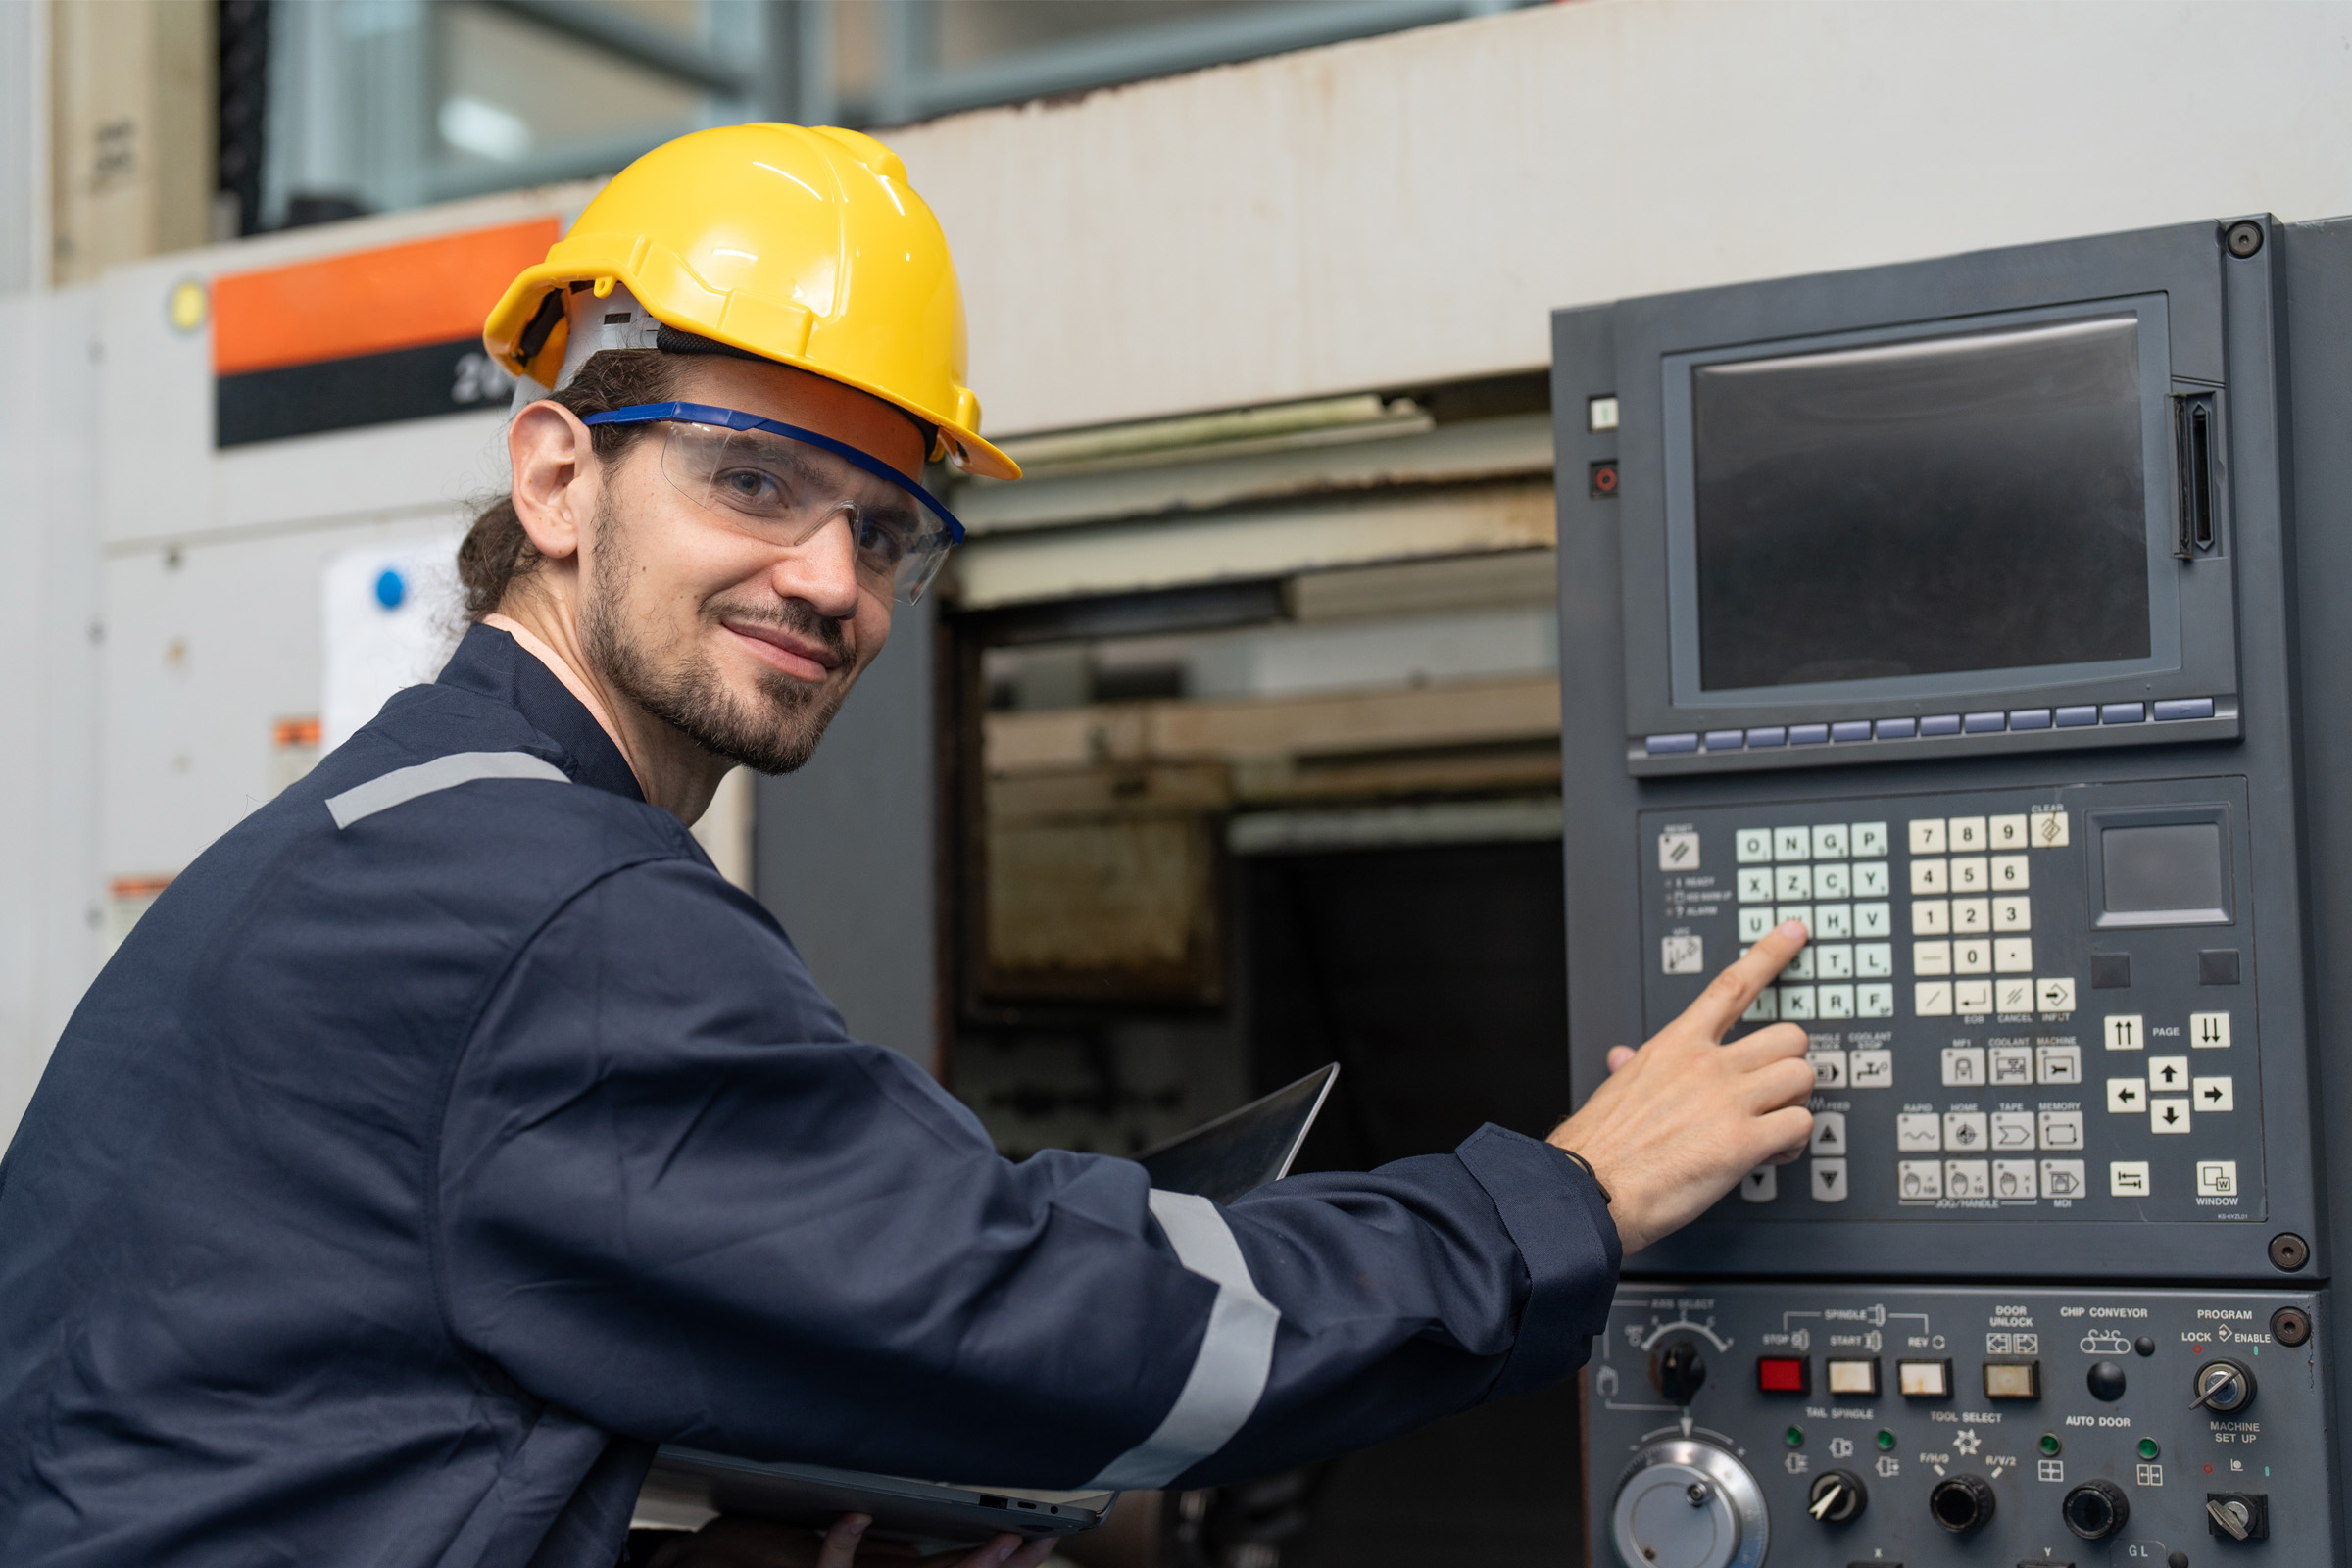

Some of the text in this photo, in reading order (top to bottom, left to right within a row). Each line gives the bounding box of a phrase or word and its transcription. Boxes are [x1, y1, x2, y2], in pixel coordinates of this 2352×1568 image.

[452, 353, 516, 403] 20
[2031, 804, 2064, 813] CLEAR
[1923, 829, 1933, 843] 7
[1963, 827, 1972, 841] 8
[2003, 825, 2013, 839] 9
[1786, 837, 1797, 851] N
[1824, 834, 1837, 849] G
[1864, 833, 1875, 846] P
[1866, 872, 1875, 886] Y
[1923, 870, 1933, 883] 4
[1964, 868, 1974, 882] 5
[2005, 866, 2015, 880] 6
[1750, 878, 1760, 892] X
[1789, 876, 1798, 890] Z
[1827, 874, 1838, 889] C
[1867, 913, 1878, 926] V
[1927, 911, 1933, 925] 1
[1966, 909, 1976, 923] 2
[2007, 907, 2016, 921] 3
[1750, 917, 1762, 931] U
[1828, 915, 1838, 928] H
[1830, 955, 1839, 968] T
[1869, 954, 1879, 967] L
[1791, 996, 1803, 1009] K
[1831, 994, 1841, 1009] R
[1870, 994, 1880, 1007] F
[1964, 1015, 1984, 1024] EOB
[1997, 1014, 2033, 1023] CANCEL
[2042, 1012, 2071, 1022] INPUT
[1848, 1031, 1892, 1041] COOLANT
[2152, 1027, 2180, 1037] PAGE
[1988, 1037, 2030, 1047] COOLANT
[2036, 1036, 2077, 1045] MACHINE
[1903, 1103, 1933, 1112] RAPID
[1950, 1103, 1978, 1112] HOME
[1999, 1102, 2025, 1111] TAPE
[2038, 1102, 2081, 1111] MEMORY
[1936, 1200, 1999, 1208] JOG/HANDLE
[2195, 1198, 2238, 1206] WINDOW
[1824, 1309, 1867, 1321] SPINDLE
[1995, 1305, 2027, 1317] DOOR
[2060, 1307, 2148, 1319] CHIP CONVEYOR
[2197, 1309, 2253, 1320] PROGRAM
[1989, 1317, 2034, 1328] UNLOCK
[1762, 1334, 1789, 1345] STOP
[1830, 1335, 1861, 1347] START
[1908, 1337, 1929, 1348] REV
[2181, 1331, 2212, 1342] LOCK
[2234, 1333, 2272, 1343] ENABLE
[1806, 1406, 1874, 1420] TAIL SPINDLE
[1931, 1411, 2002, 1424] TOOL SELECT
[2066, 1415, 2131, 1427] AUTO DOOR
[2211, 1421, 2260, 1432] MACHINE
[2215, 1433, 2257, 1443] SET UP
[1874, 1548, 1884, 1558] X
[2044, 1547, 2052, 1557] Y
